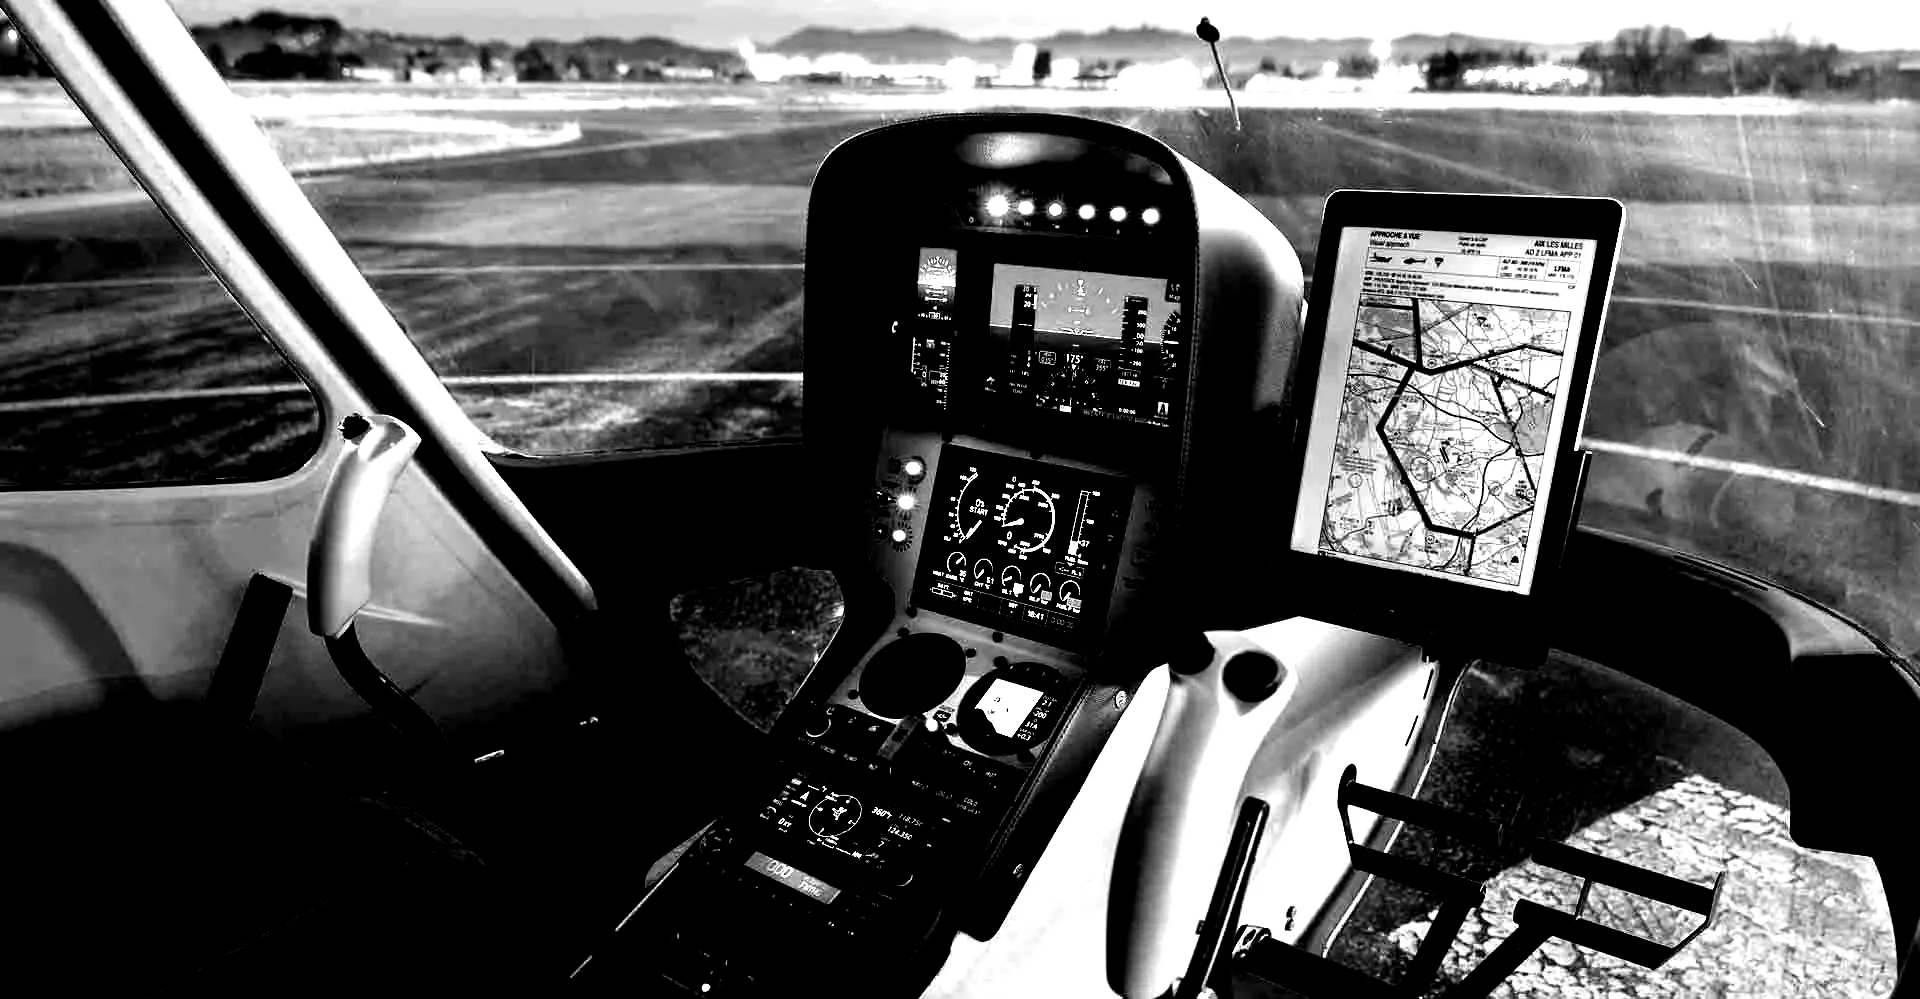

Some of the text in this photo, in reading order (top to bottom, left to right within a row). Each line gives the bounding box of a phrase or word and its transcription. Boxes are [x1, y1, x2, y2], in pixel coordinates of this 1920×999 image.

[1370, 231, 1403, 239] APPROCHE
[1546, 240, 1560, 249] LES
[1560, 241, 1584, 250] MILLES
[969, 505, 989, 517] START
